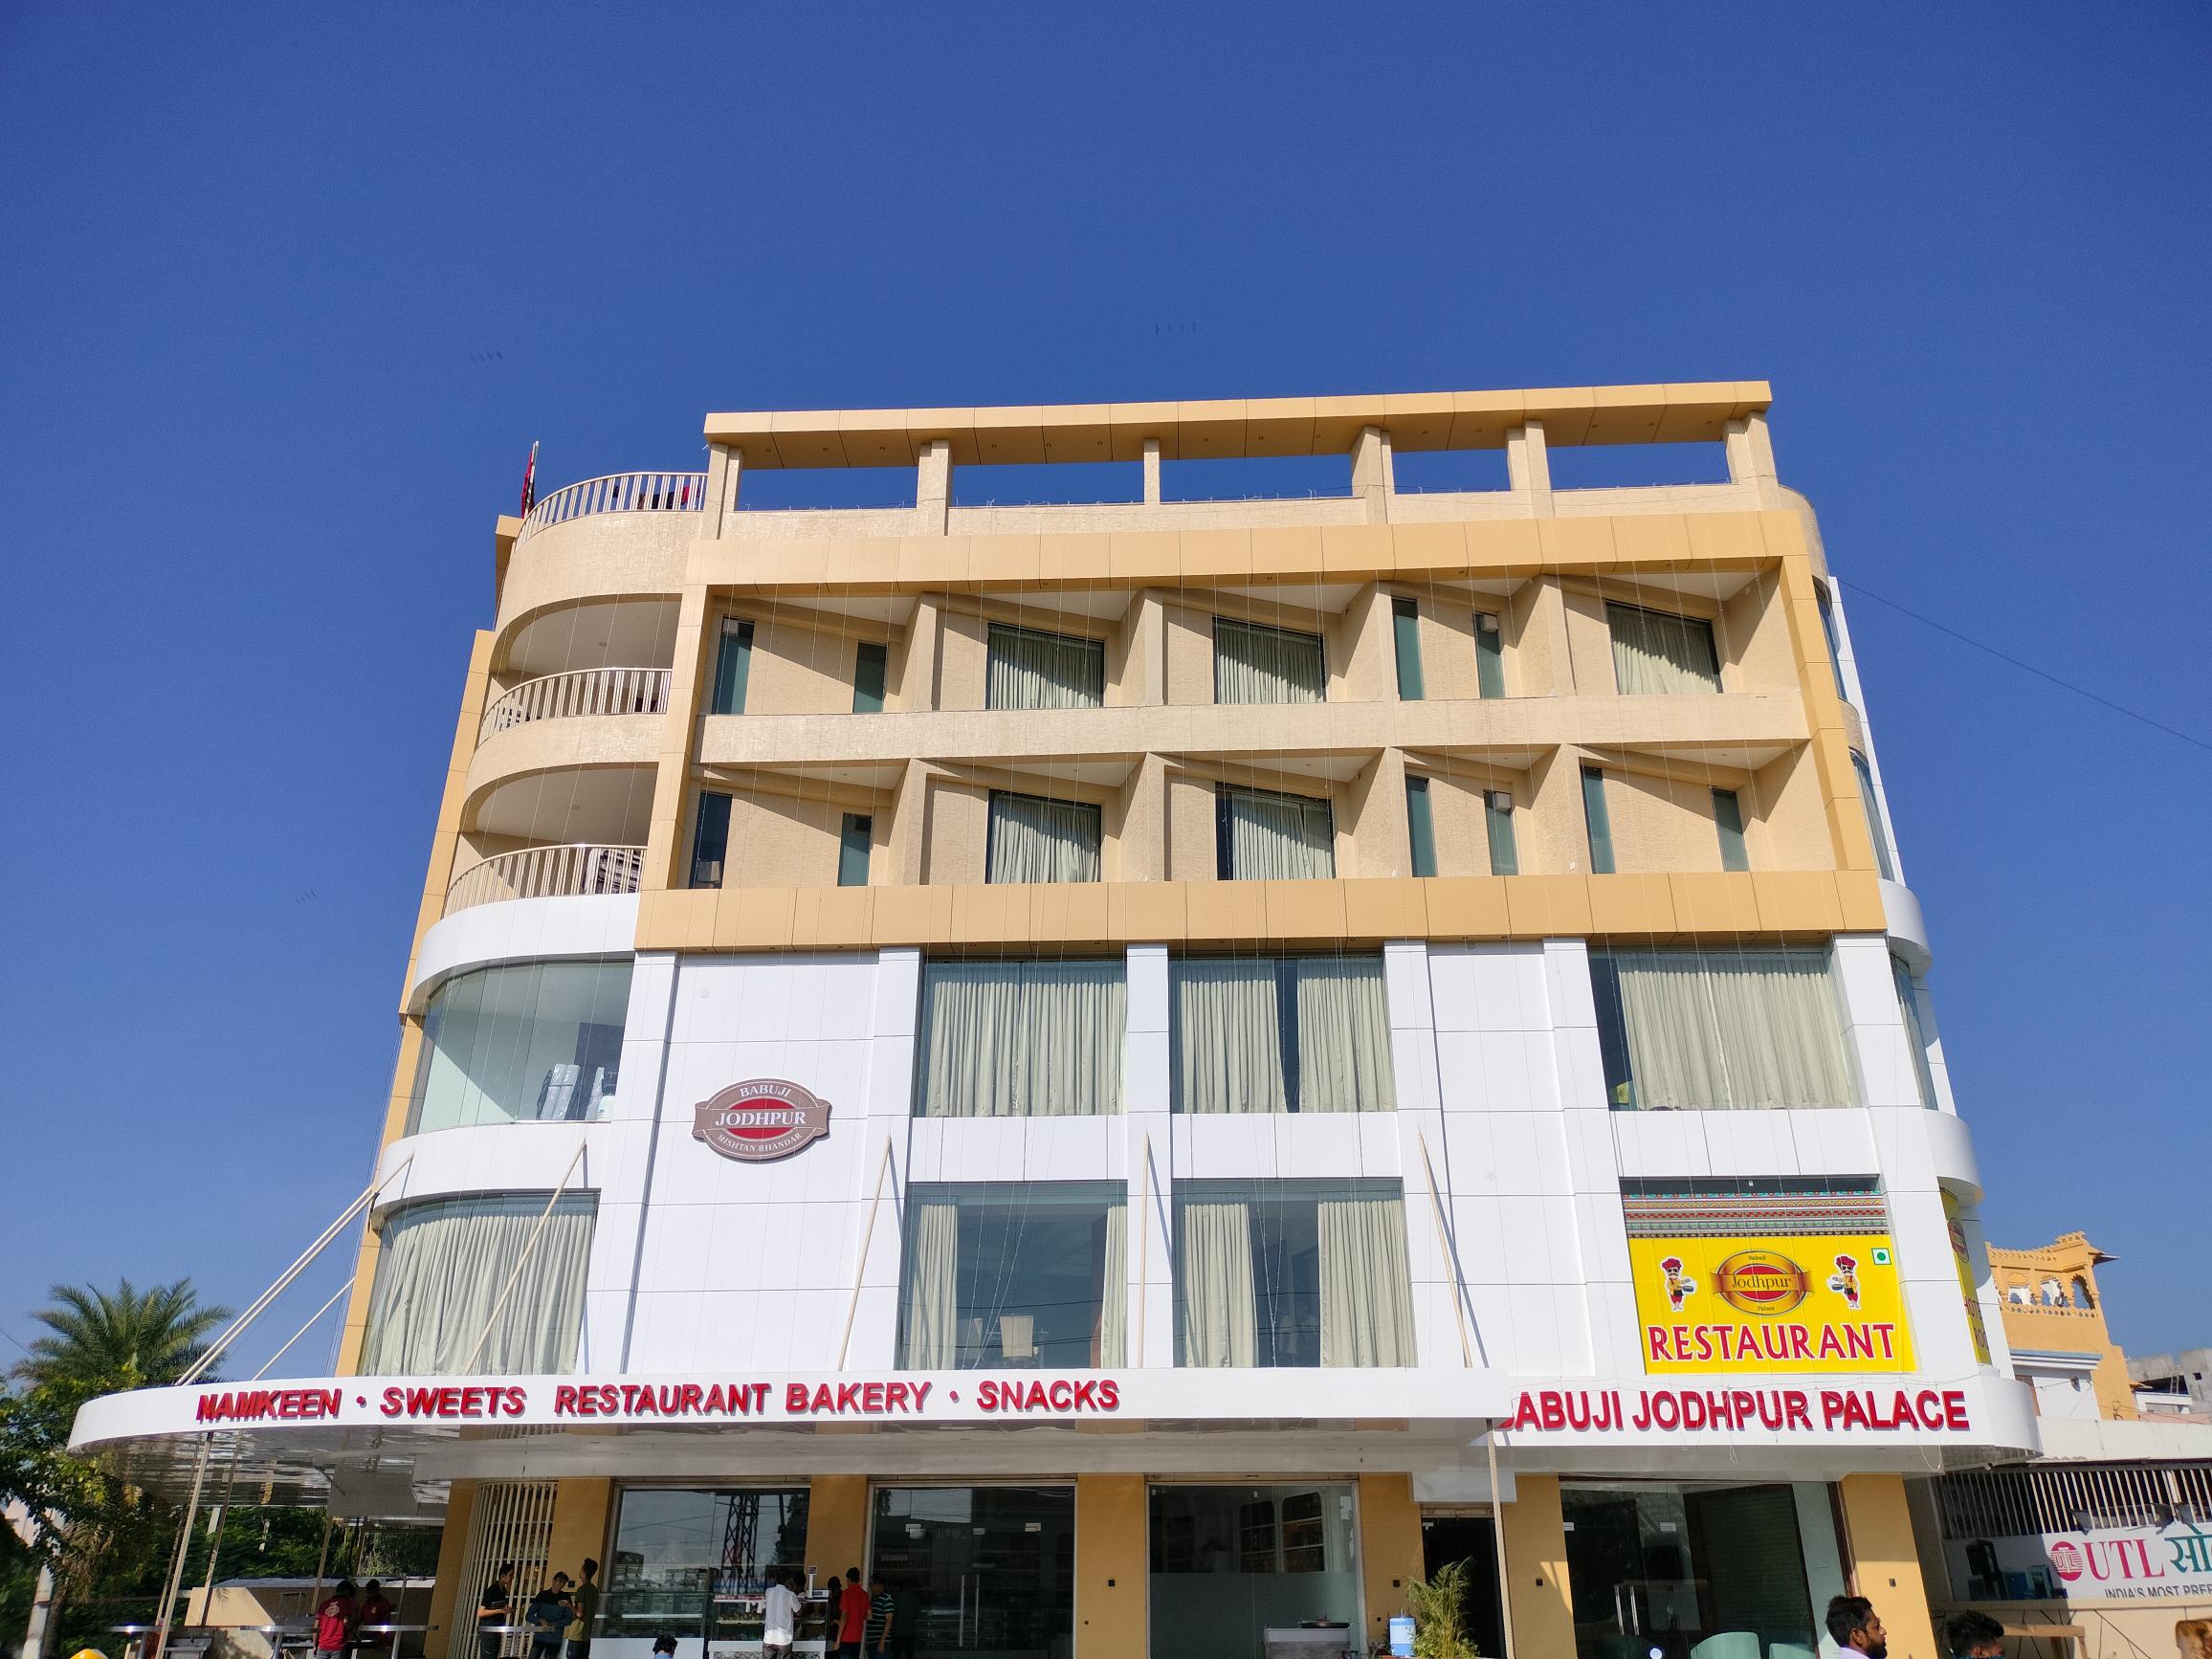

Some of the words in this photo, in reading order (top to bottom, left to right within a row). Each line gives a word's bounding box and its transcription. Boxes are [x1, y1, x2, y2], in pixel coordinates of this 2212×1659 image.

[739, 1084, 792, 1097] BABUJI
[715, 1110, 807, 1126] JODHPUR
[718, 1134, 756, 1152] MISHTAN
[758, 1133, 803, 1152] BHANDAR
[1732, 1275, 1792, 1290] Jodhpur
[1648, 1323, 1894, 1361] RESTAURANT
[196, 1388, 342, 1421] NAMKEEN
[379, 1386, 526, 1416] SWEETS
[554, 1383, 770, 1415] RESTAURANT
[785, 1382, 931, 1412] BAKERY
[976, 1379, 1118, 1410] SNACKS
[1495, 1390, 1624, 1430] ABUJI
[1632, 1390, 1814, 1430] JODHPUR
[1820, 1390, 1970, 1430] PALACE
[2082, 1538, 2165, 1581] UTL
[2164, 1521, 2212, 1574] सो
[2105, 1587, 2146, 1599] INDIA'S
[2147, 1585, 2179, 1598] MOST
